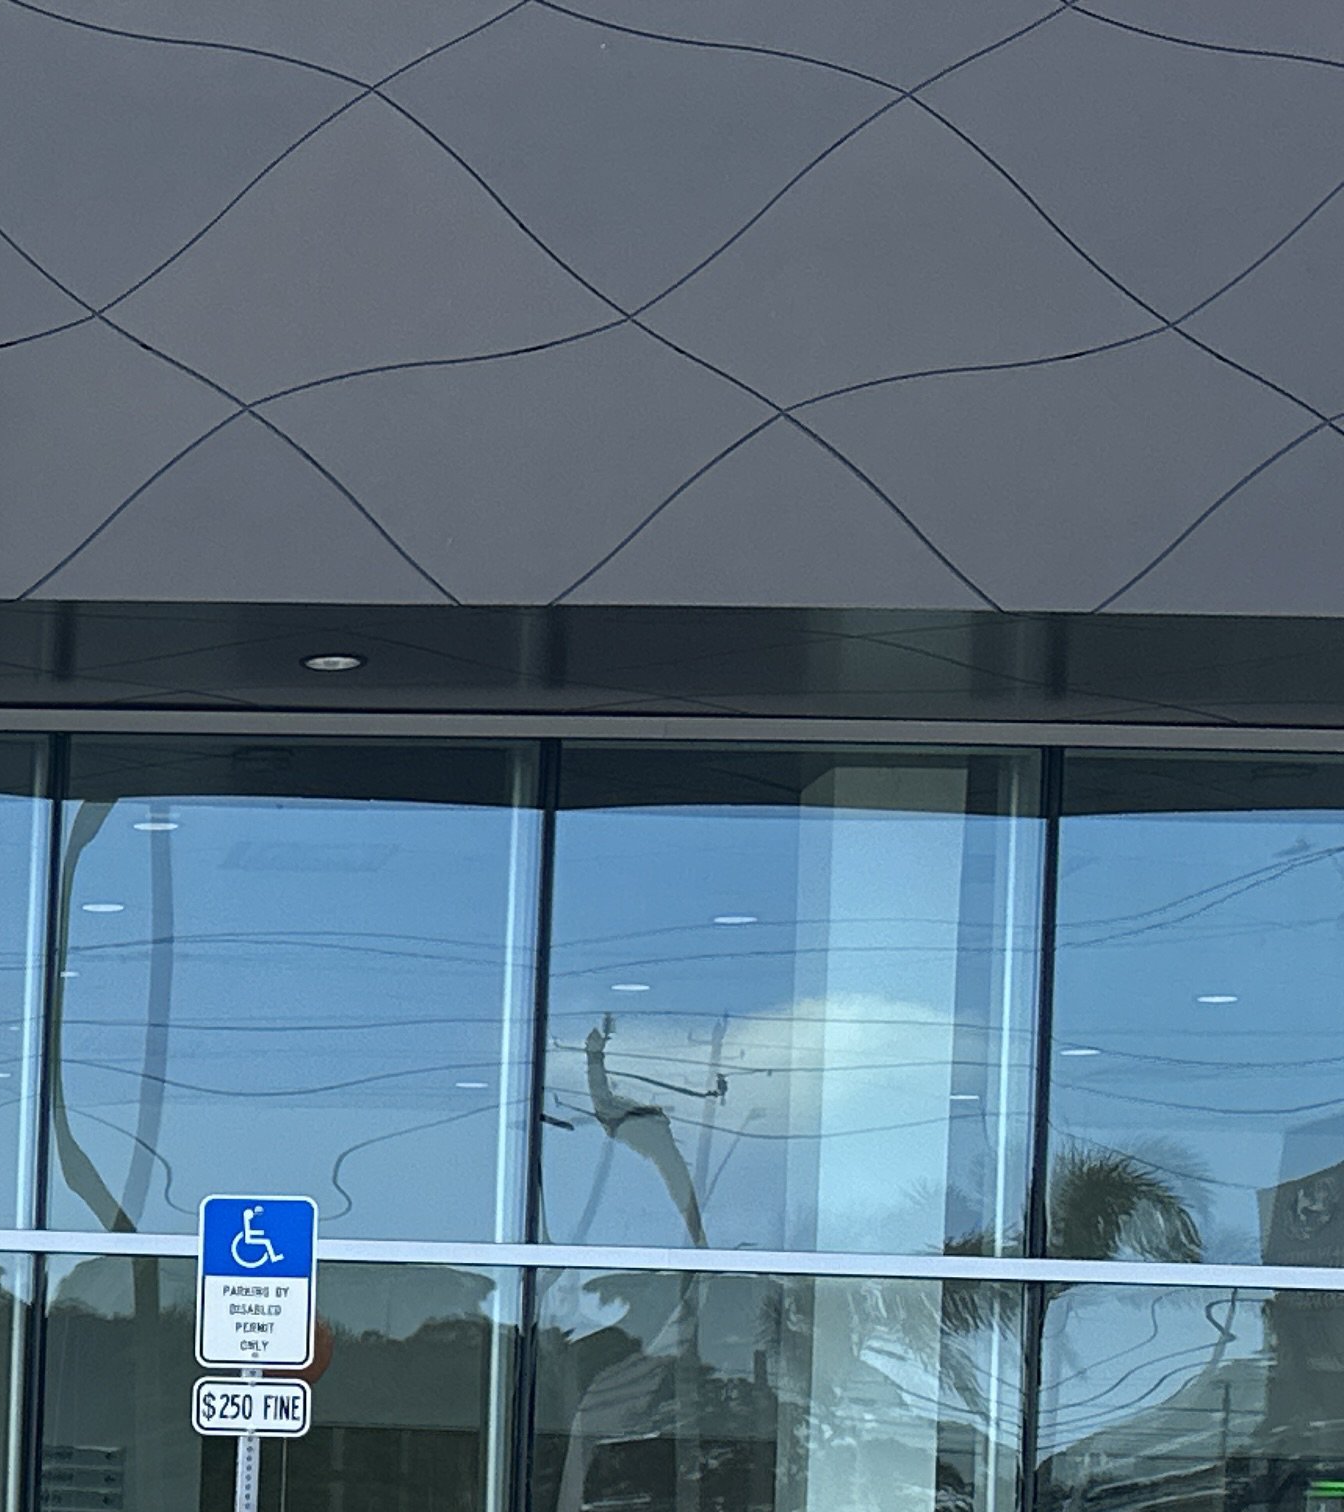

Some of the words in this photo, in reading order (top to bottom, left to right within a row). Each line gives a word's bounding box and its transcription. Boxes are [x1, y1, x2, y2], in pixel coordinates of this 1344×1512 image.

[223, 1285, 269, 1297] PARKING
[276, 1287, 289, 1297] BY
[229, 1304, 281, 1315] DISABLED
[235, 1322, 274, 1333] PERMIT
[240, 1340, 269, 1351] ONLY
[202, 1392, 253, 1421] $250
[263, 1395, 300, 1421] FINE
